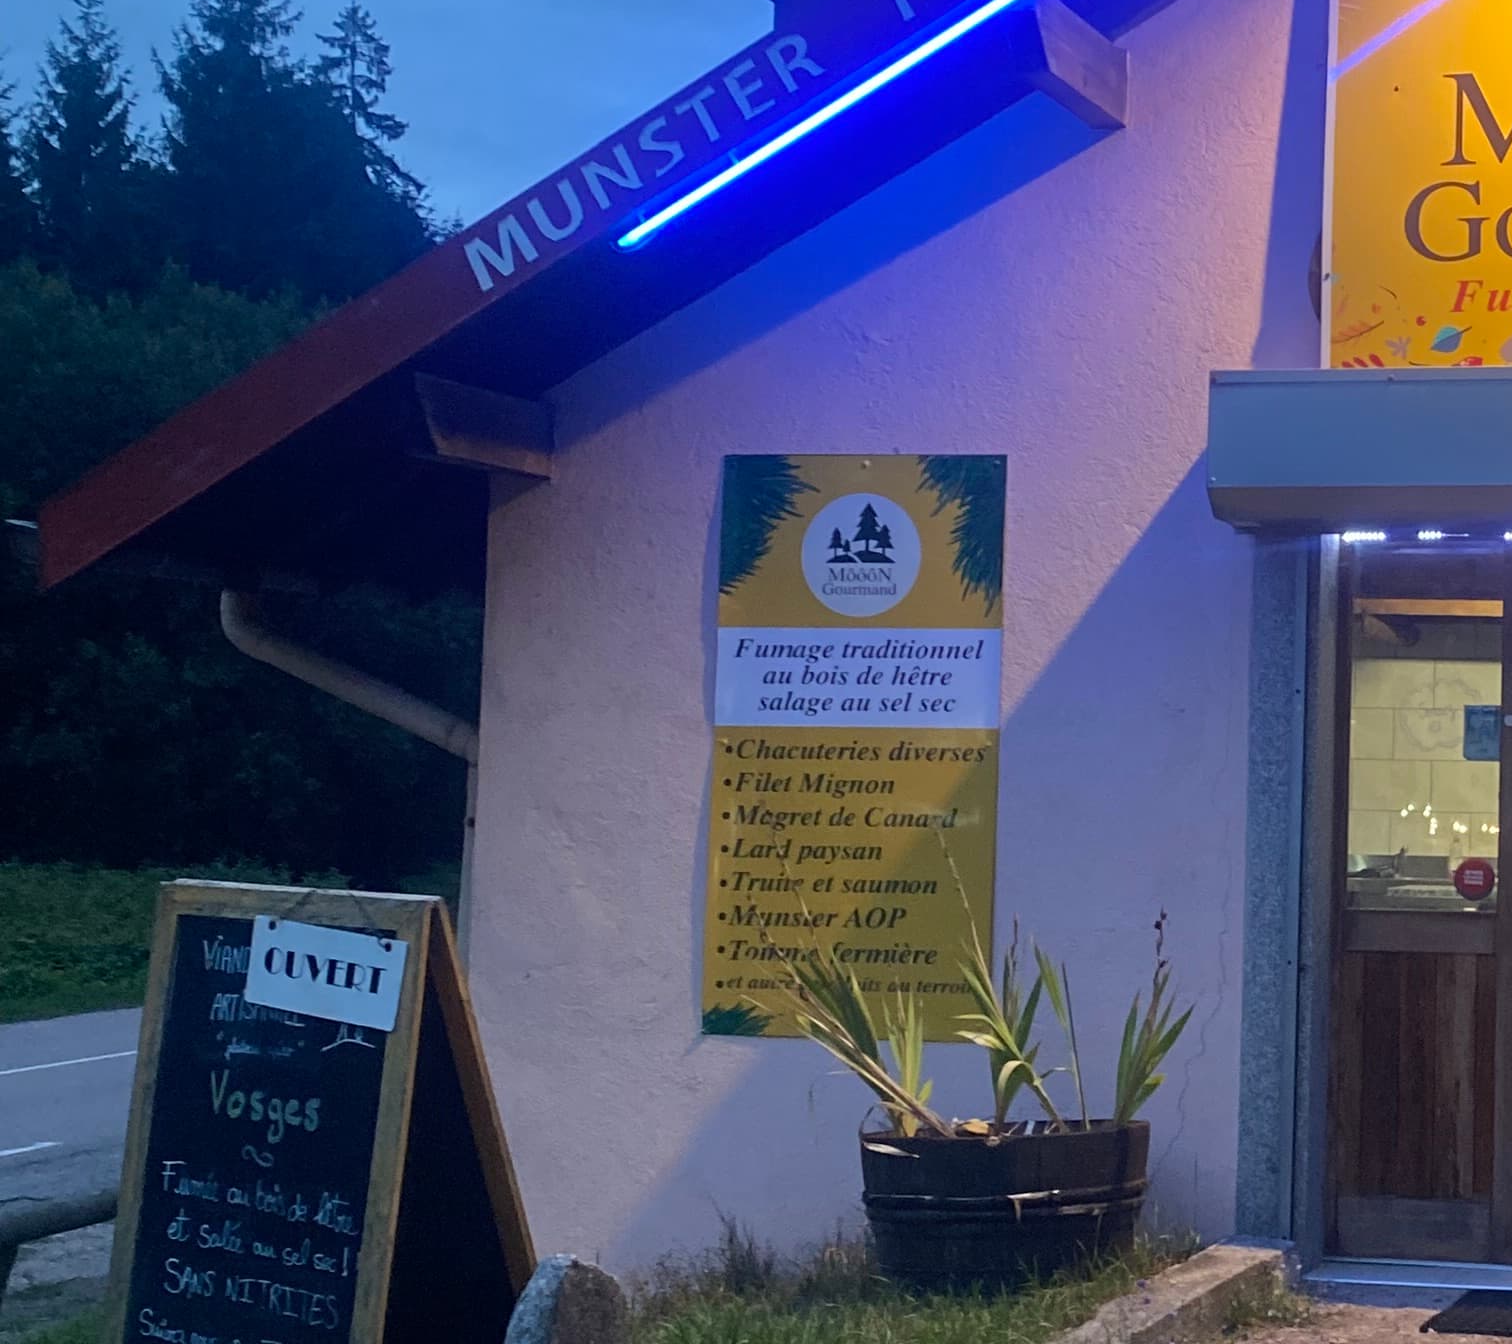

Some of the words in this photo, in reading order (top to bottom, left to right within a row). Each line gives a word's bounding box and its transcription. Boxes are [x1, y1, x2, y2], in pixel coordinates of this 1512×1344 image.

[463, 32, 827, 292] MUNSTER
[821, 582, 898, 597] Gourmand
[735, 637, 835, 664] Fumage
[841, 638, 985, 661] traditionnel
[762, 668, 793, 686] au
[801, 665, 849, 686] bois
[856, 666, 883, 686] de
[891, 665, 953, 687] hêtre
[758, 691, 833, 717] salage
[840, 697, 870, 713] au
[878, 692, 912, 713] sel
[918, 697, 957, 713] sec
[736, 738, 882, 763] Chacuteries
[888, 740, 986, 763] diverses
[734, 771, 793, 794] Filet
[798, 772, 896, 799] Mignon
[828, 806, 856, 828] de
[864, 807, 959, 830] Canard
[731, 838, 792, 861] Lard
[797, 844, 883, 866] paysan
[811, 876, 834, 893] et
[840, 877, 938, 895] saumon
[727, 904, 839, 929] Munster
[843, 906, 908, 930] AOP
[263, 946, 388, 995] OUVERT
[726, 975, 744, 991] et
[747, 976, 803, 991] autre
[915, 976, 974, 995] terroi
[209, 1068, 321, 1144] Vosges
[224, 1275, 339, 1330] NITRITES
